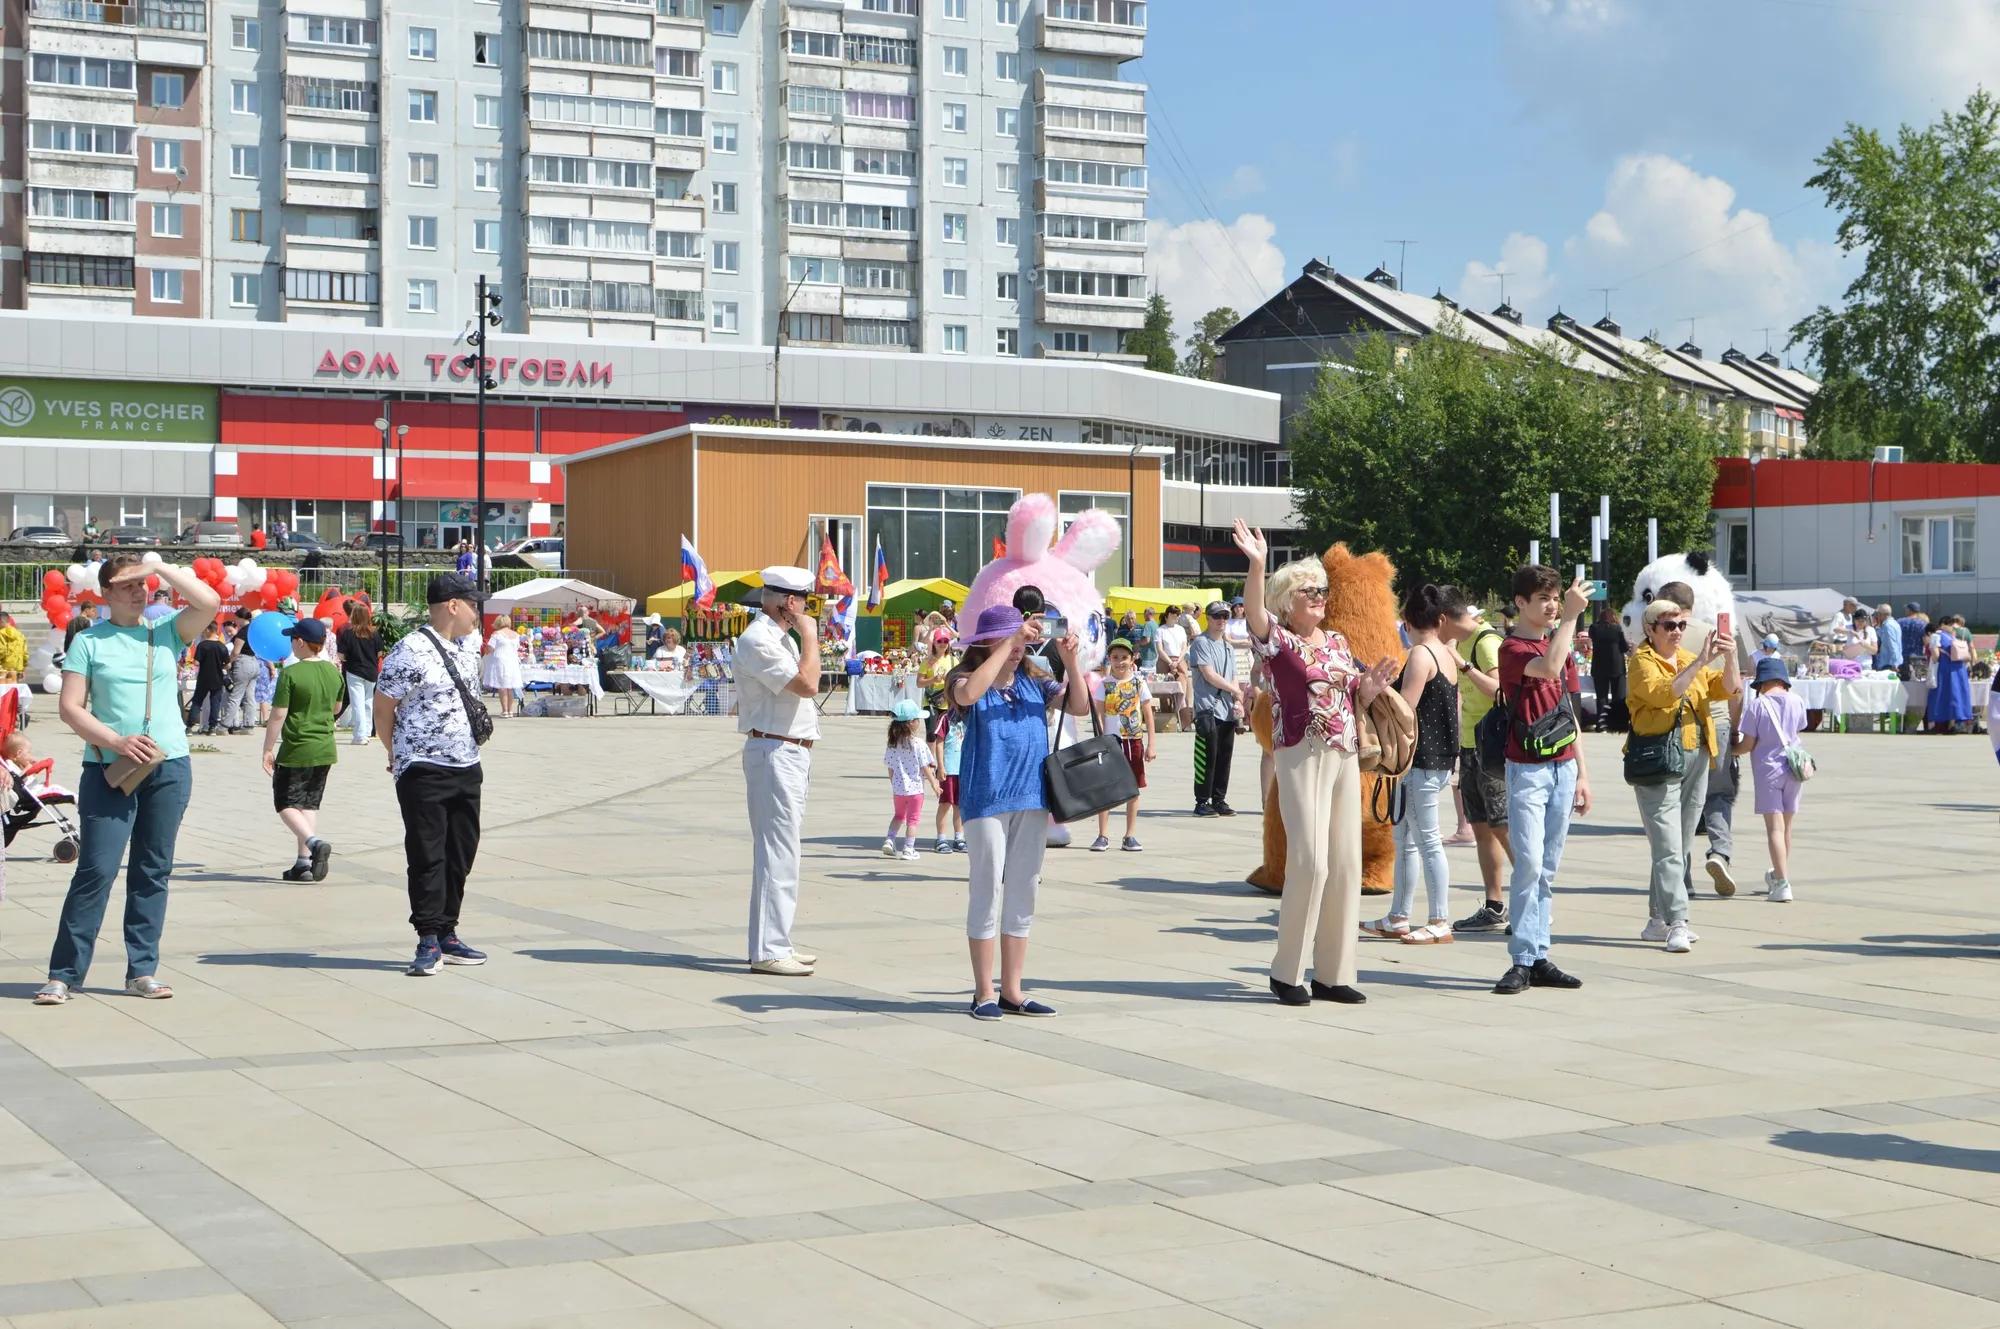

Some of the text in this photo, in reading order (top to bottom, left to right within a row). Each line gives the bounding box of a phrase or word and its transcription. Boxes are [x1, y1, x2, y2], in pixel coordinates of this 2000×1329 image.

[316, 349, 613, 384] ДОМ ТОРГОВЛИ
[43, 399, 205, 421] YVES ROCHER
[81, 420, 164, 432] FRANCE
[1018, 426, 1053, 441] ZEN
